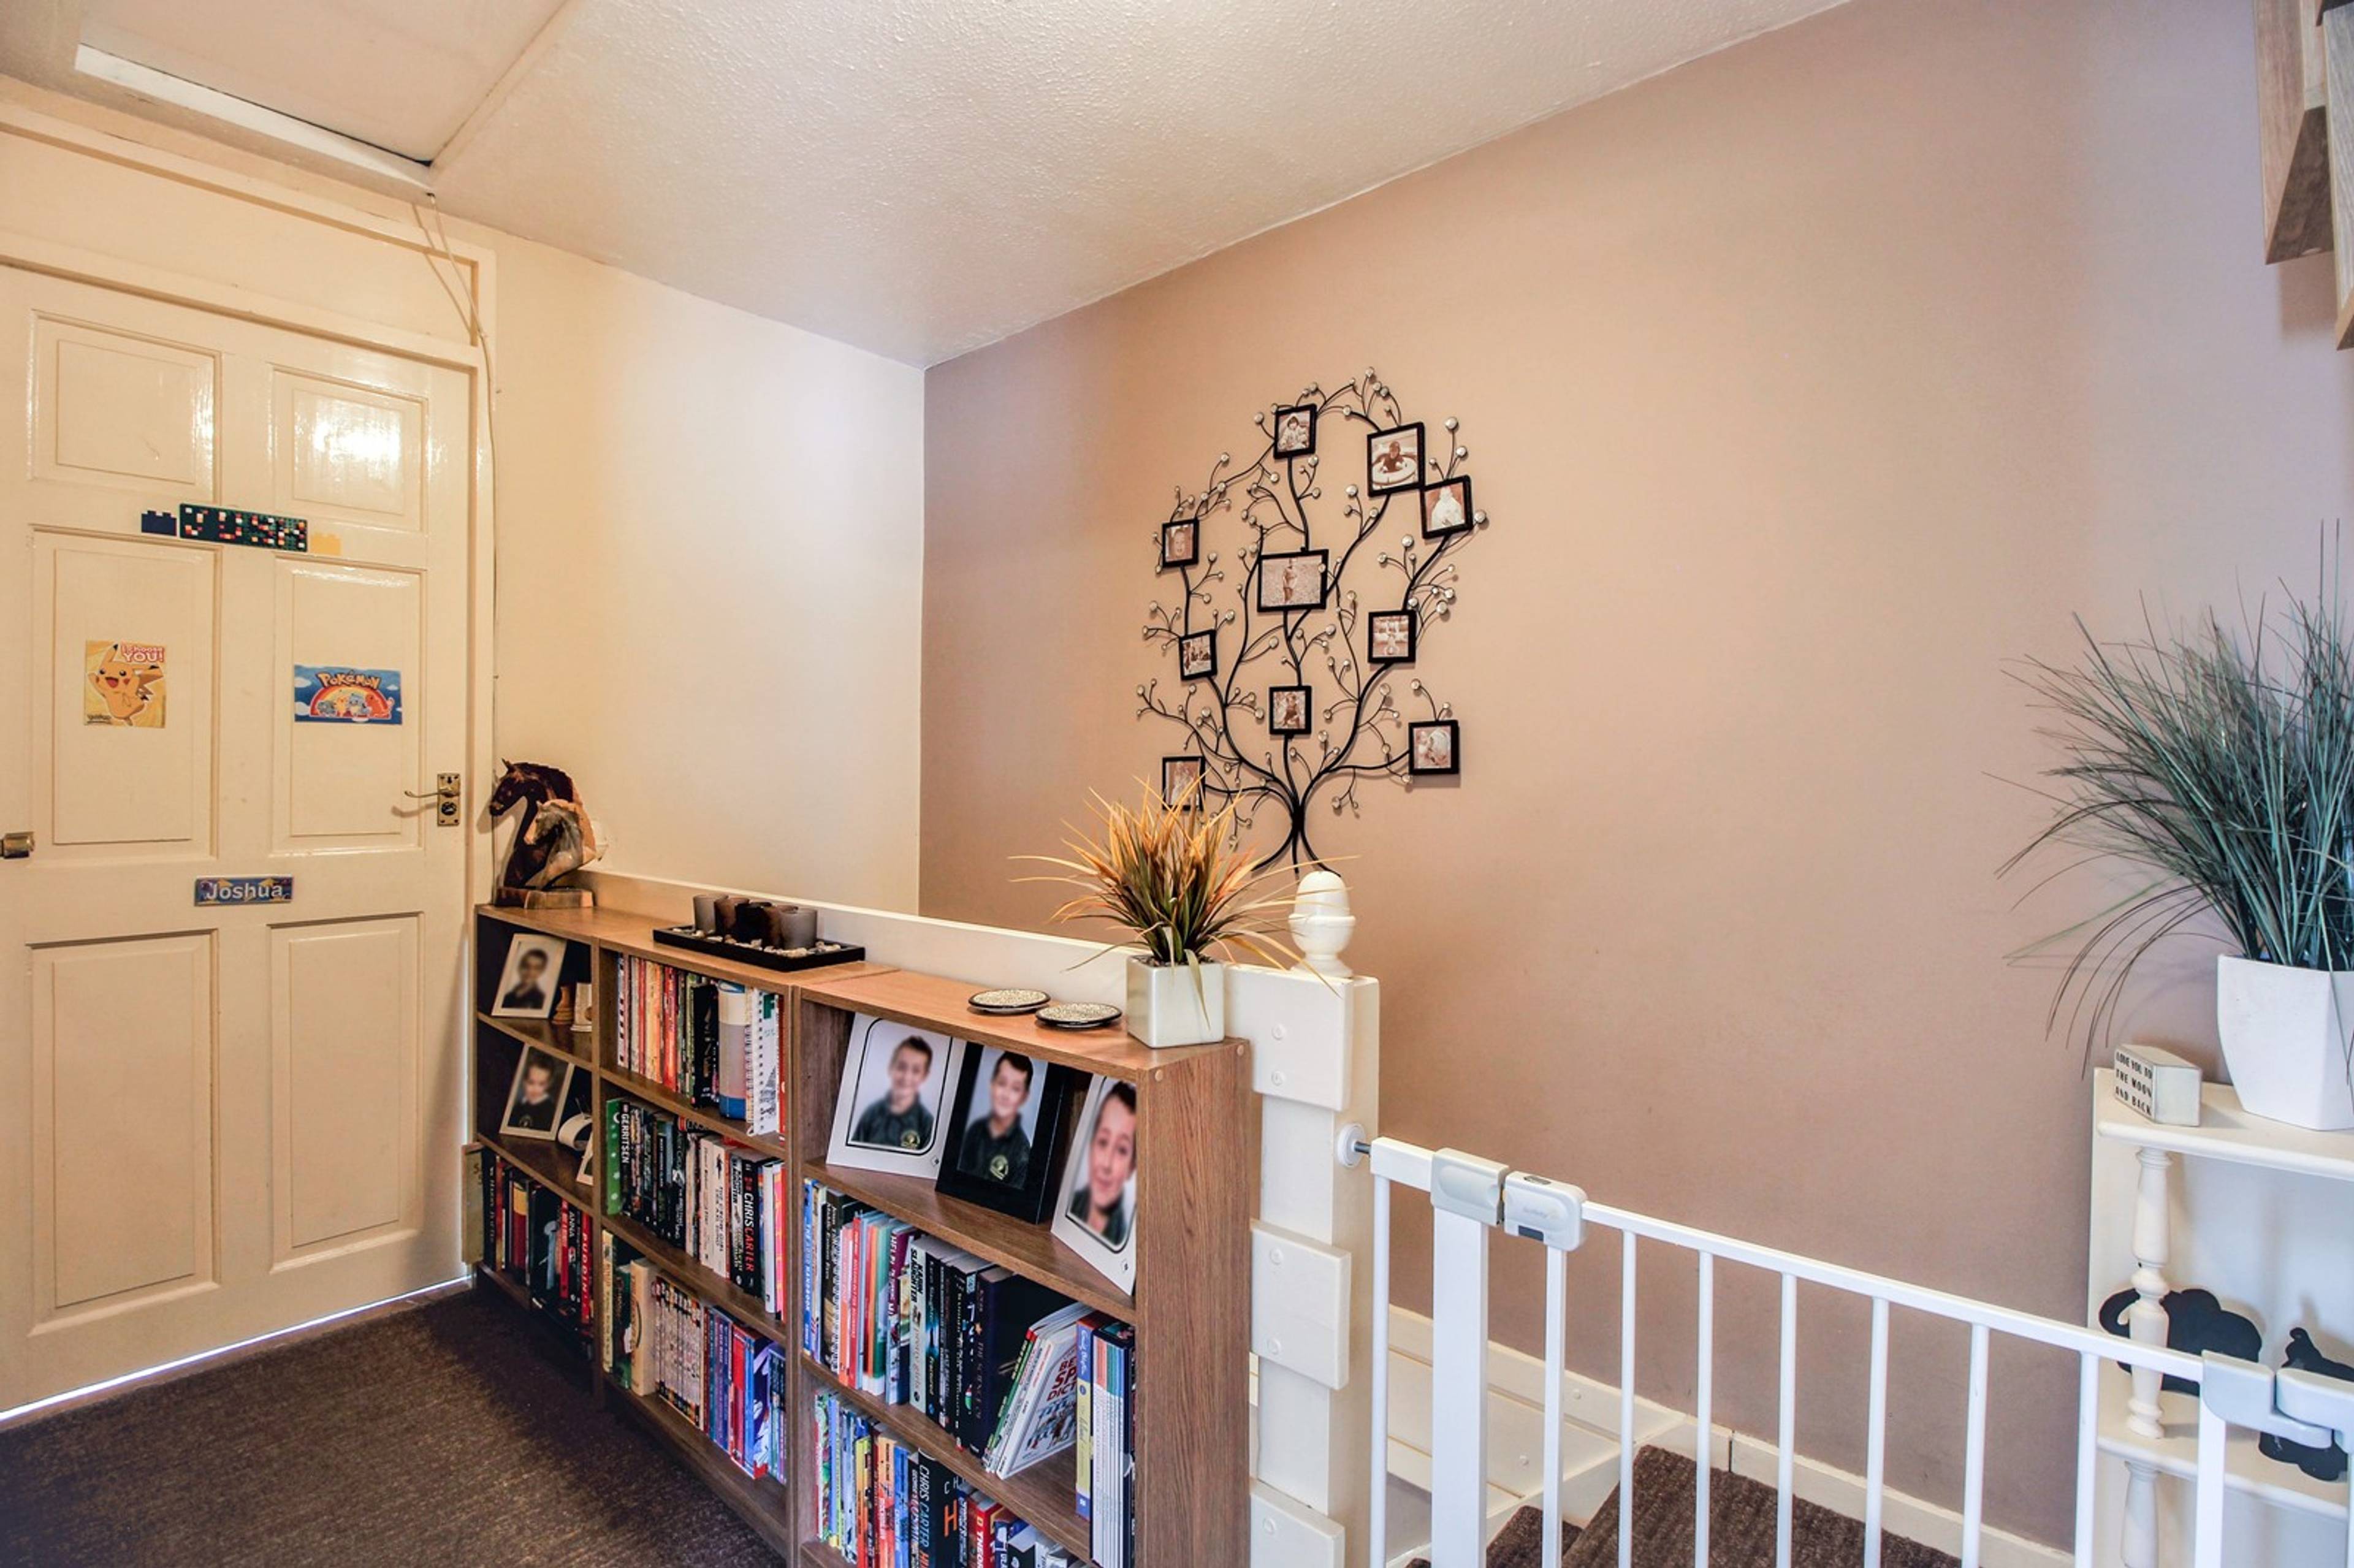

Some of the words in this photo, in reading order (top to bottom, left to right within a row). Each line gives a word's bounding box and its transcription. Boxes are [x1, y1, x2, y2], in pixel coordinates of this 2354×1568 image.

[123, 652, 164, 662] YOU!
[206, 883, 282, 899] Joshua
[2116, 1068, 2128, 1084] THE
[2131, 1077, 2152, 1098] MOON
[2115, 1086, 2129, 1101] AND
[2131, 1095, 2152, 1116] BACK
[621, 1114, 630, 1163] GERRITSEN
[744, 1193, 754, 1227] CHRIS
[745, 1227, 754, 1271] CARTER
[920, 1464, 929, 1501] CHRIS
[920, 1501, 929, 1547] CARTER
